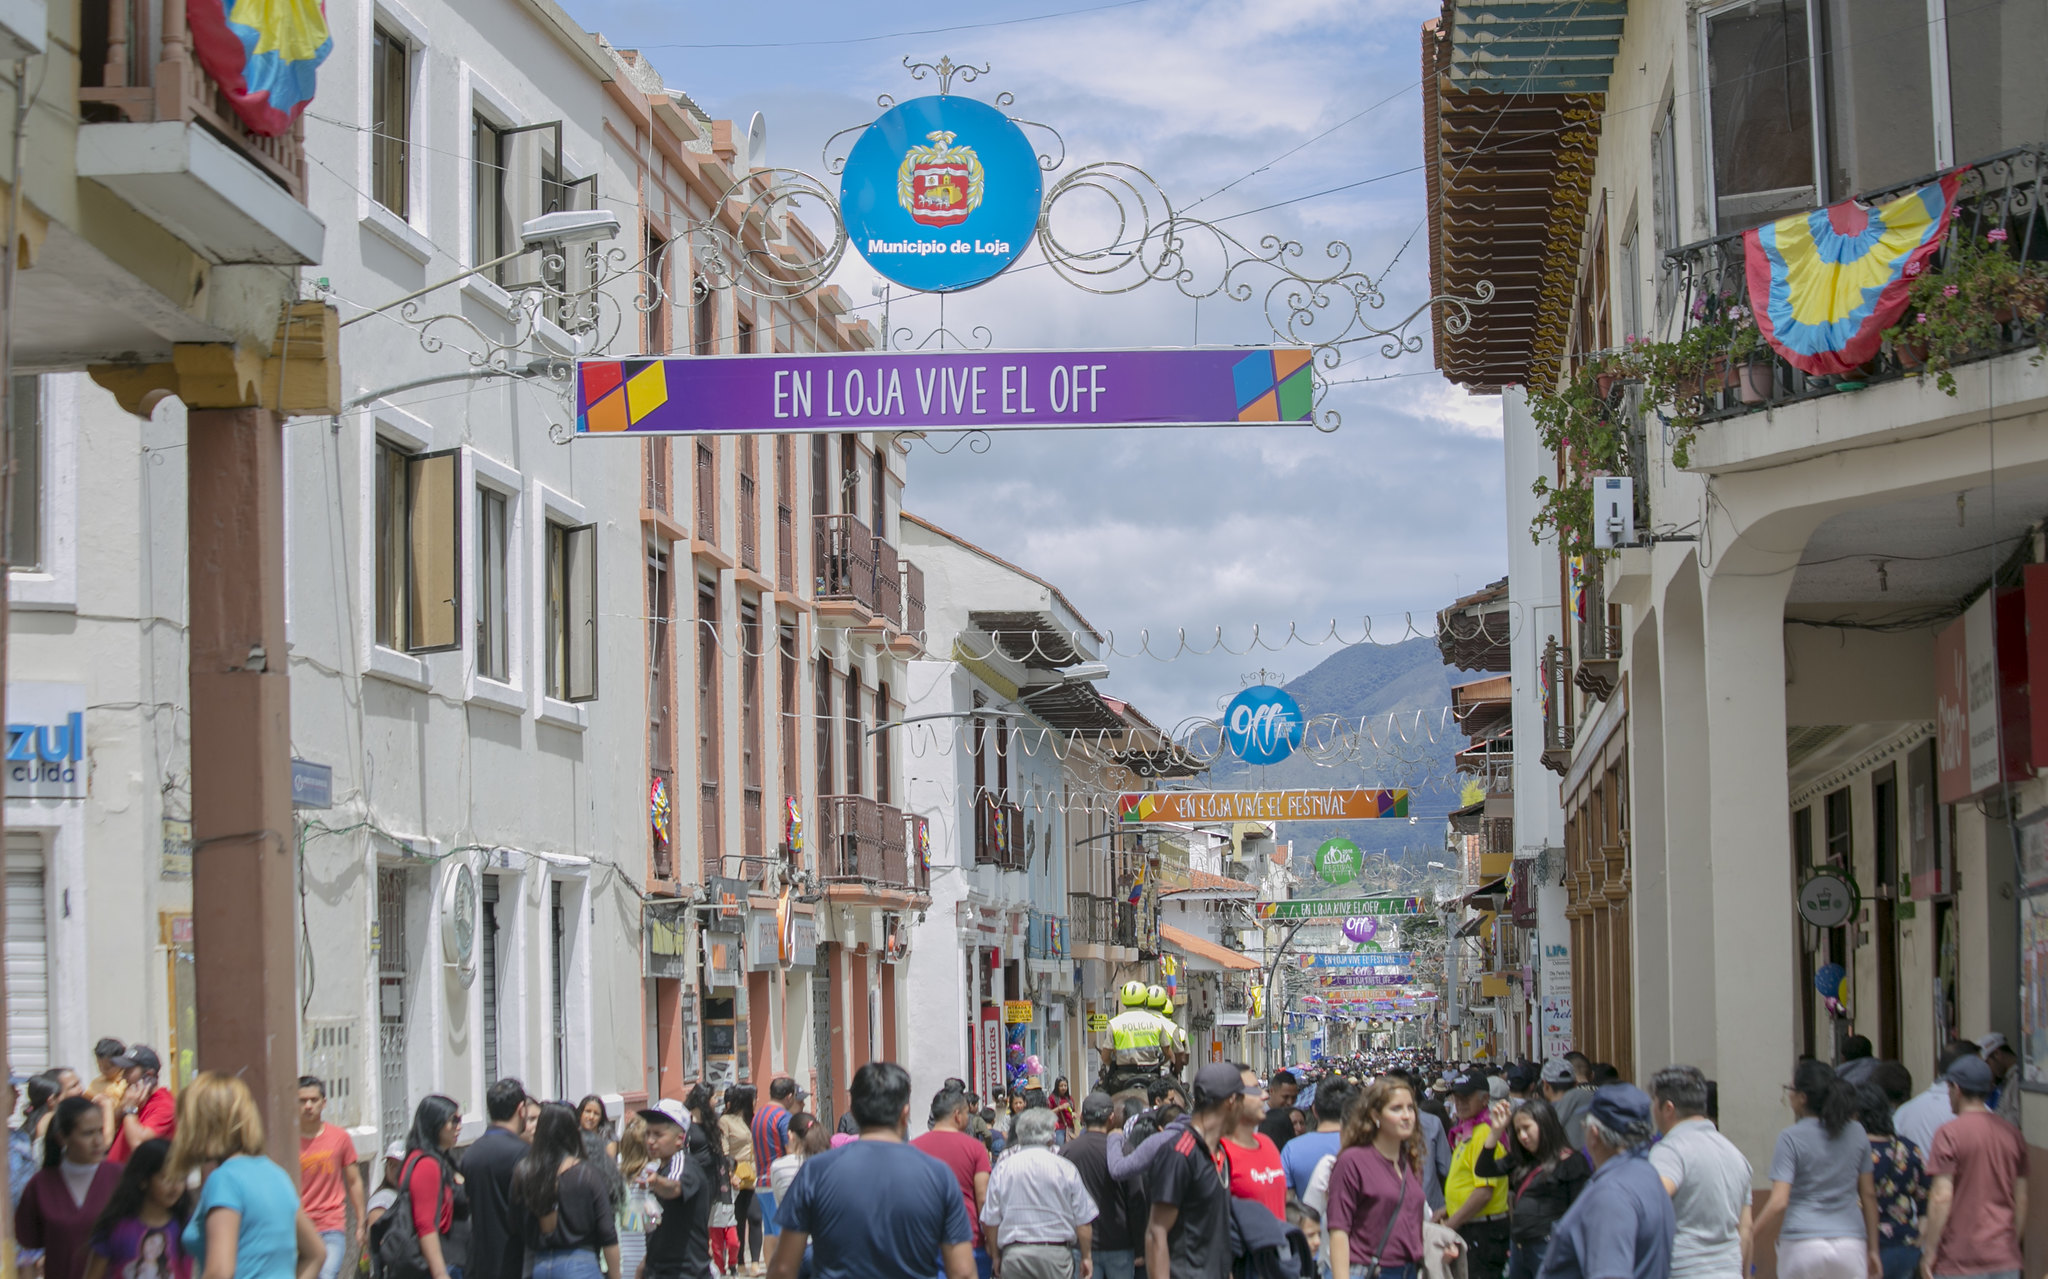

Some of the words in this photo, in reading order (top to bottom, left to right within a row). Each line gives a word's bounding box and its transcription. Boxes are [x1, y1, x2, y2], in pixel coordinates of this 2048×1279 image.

[868, 239, 947, 256] Municipio
[950, 239, 971, 253] de
[975, 239, 1010, 256] Loja
[774, 370, 813, 418] EN
[827, 368, 906, 417] LOJA
[915, 366, 987, 415] VIVE
[1002, 365, 1036, 414] EL
[1050, 364, 1107, 413] OFF
[12, 761, 75, 783] cuida
[1180, 798, 1196, 818] EN
[1200, 797, 1232, 818] LOJA
[1236, 796, 1264, 818] VIVE
[1269, 796, 1283, 817] EL
[1288, 795, 1347, 817] FESTIVAL
[1301, 903, 1311, 916] EN
[1122, 1022, 1155, 1033] POLICIA
